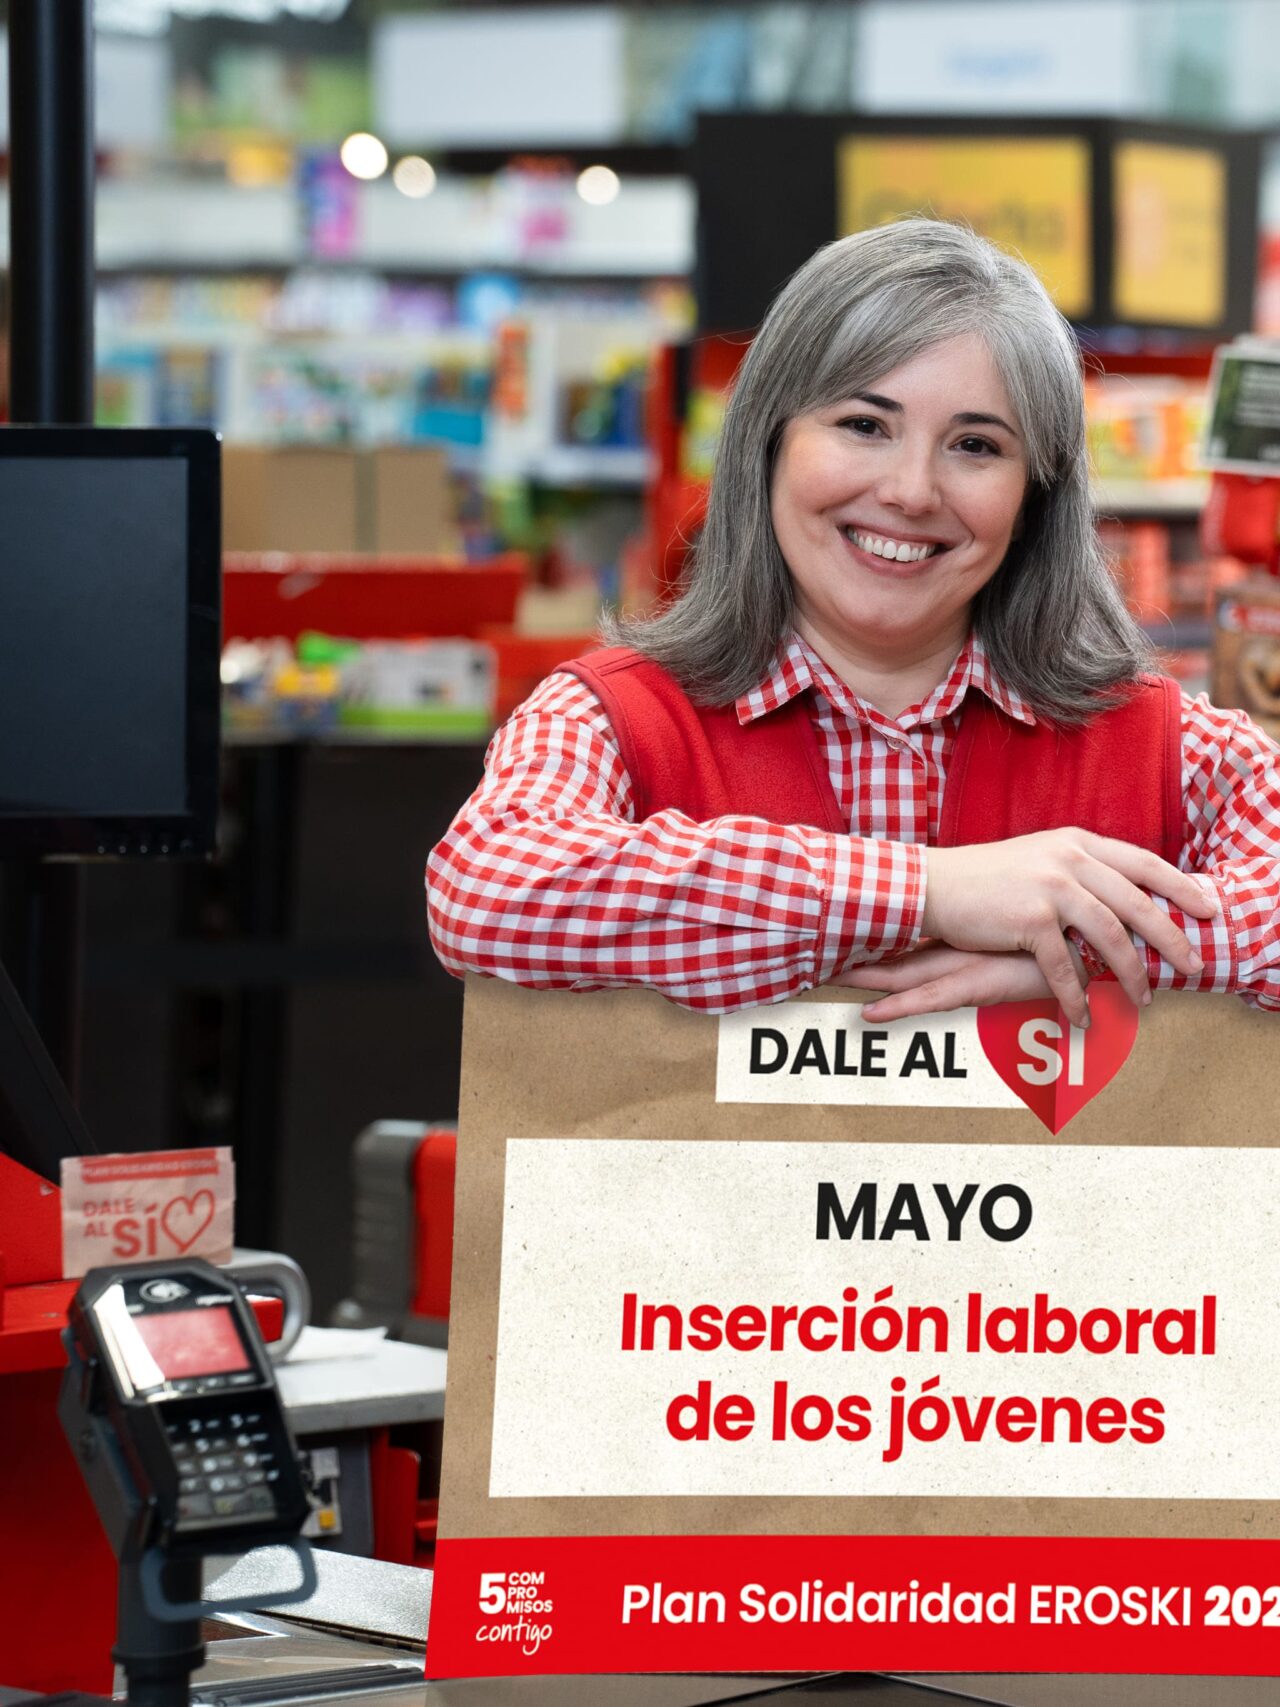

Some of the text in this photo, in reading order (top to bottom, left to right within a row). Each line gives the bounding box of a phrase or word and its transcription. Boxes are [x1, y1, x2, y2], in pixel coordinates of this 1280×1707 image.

[749, 1027, 889, 1077] DALE
[899, 1031, 968, 1079] AL
[82, 1198, 135, 1217] DALE
[83, 1202, 159, 1258] AL SÍ
[815, 1182, 1033, 1242] MAYO
[621, 1285, 1217, 1355] Inserción laboral
[666, 1375, 1165, 1463] de los jóvenes
[478, 1571, 545, 1615] 5 COM
[506, 1599, 553, 1614] MISOS
[507, 1586, 538, 1600] PRO
[621, 1582, 726, 1624] Plan
[739, 1579, 1016, 1624] Solidaridad
[1029, 1584, 1192, 1627] EROSKI
[475, 1614, 553, 1656] contigo
